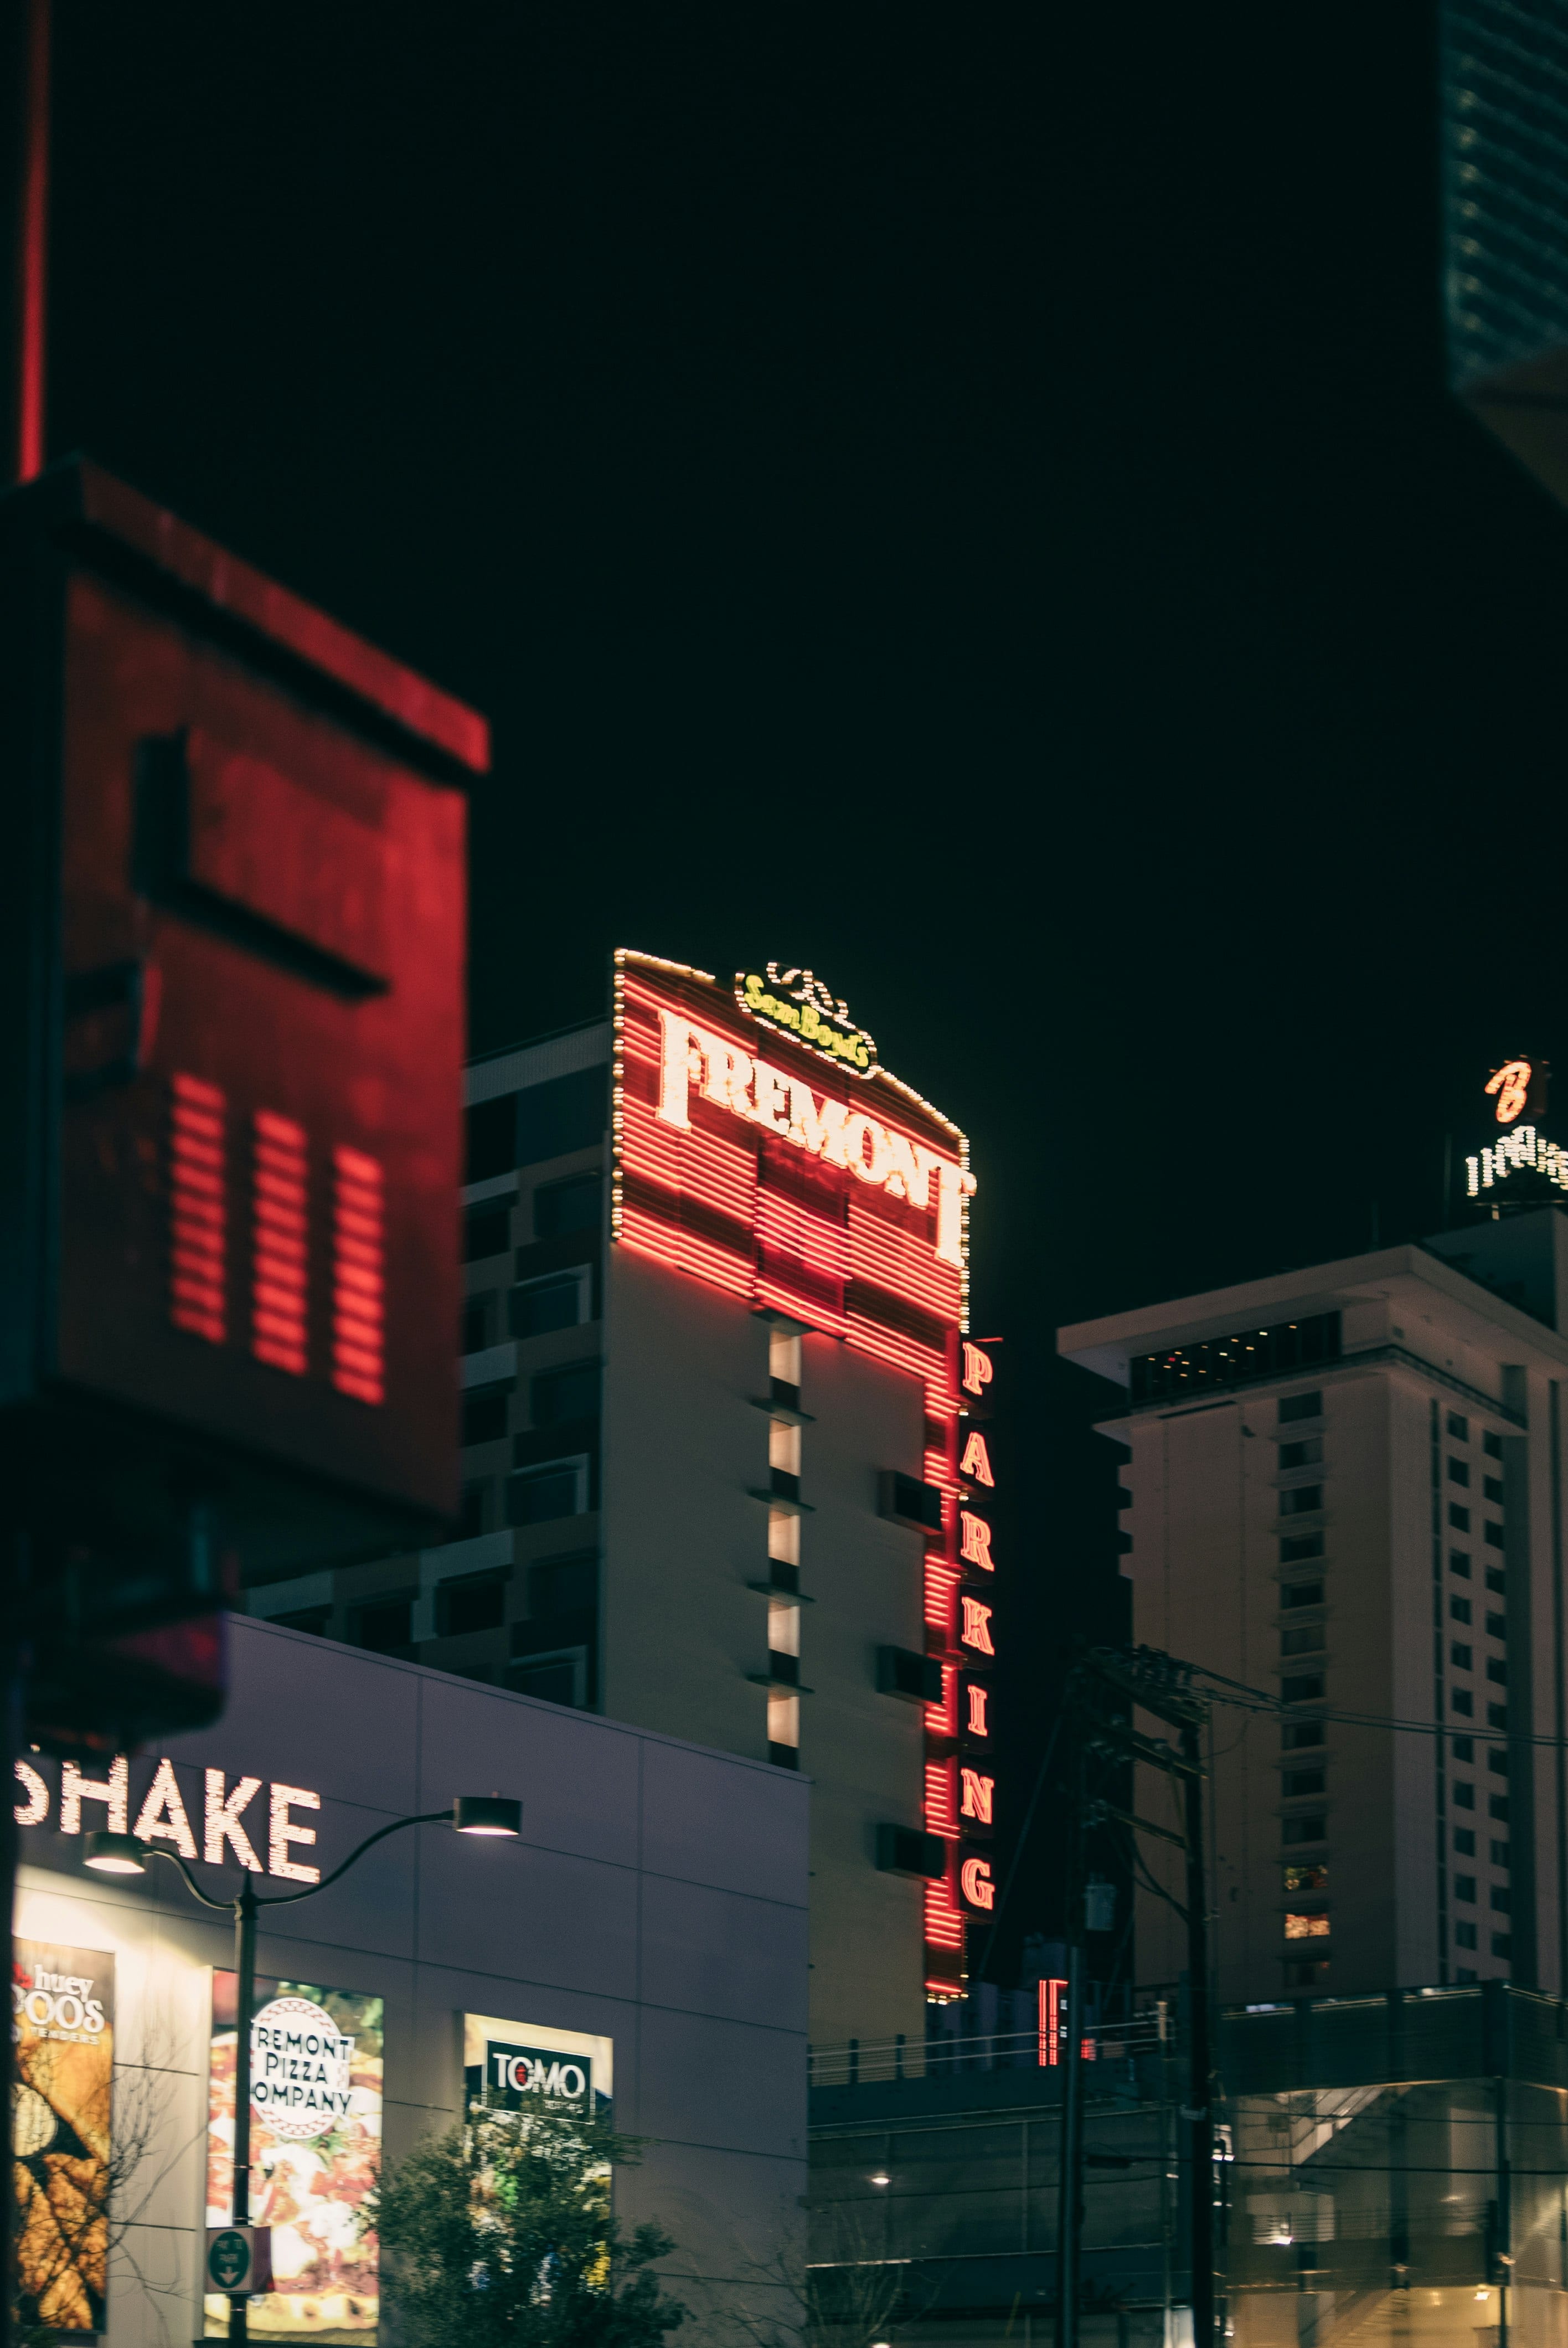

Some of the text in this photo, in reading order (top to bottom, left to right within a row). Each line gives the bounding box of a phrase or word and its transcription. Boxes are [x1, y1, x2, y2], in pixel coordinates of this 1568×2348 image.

[656, 1007, 977, 1268] FREMONT
[960, 1341, 994, 1911] PARKING
[34, 1964, 94, 2003] huey
[265, 2052, 328, 2084] PIZZA
[492, 2052, 585, 2099] TOMO
[254, 2081, 352, 2115] OMPANY
